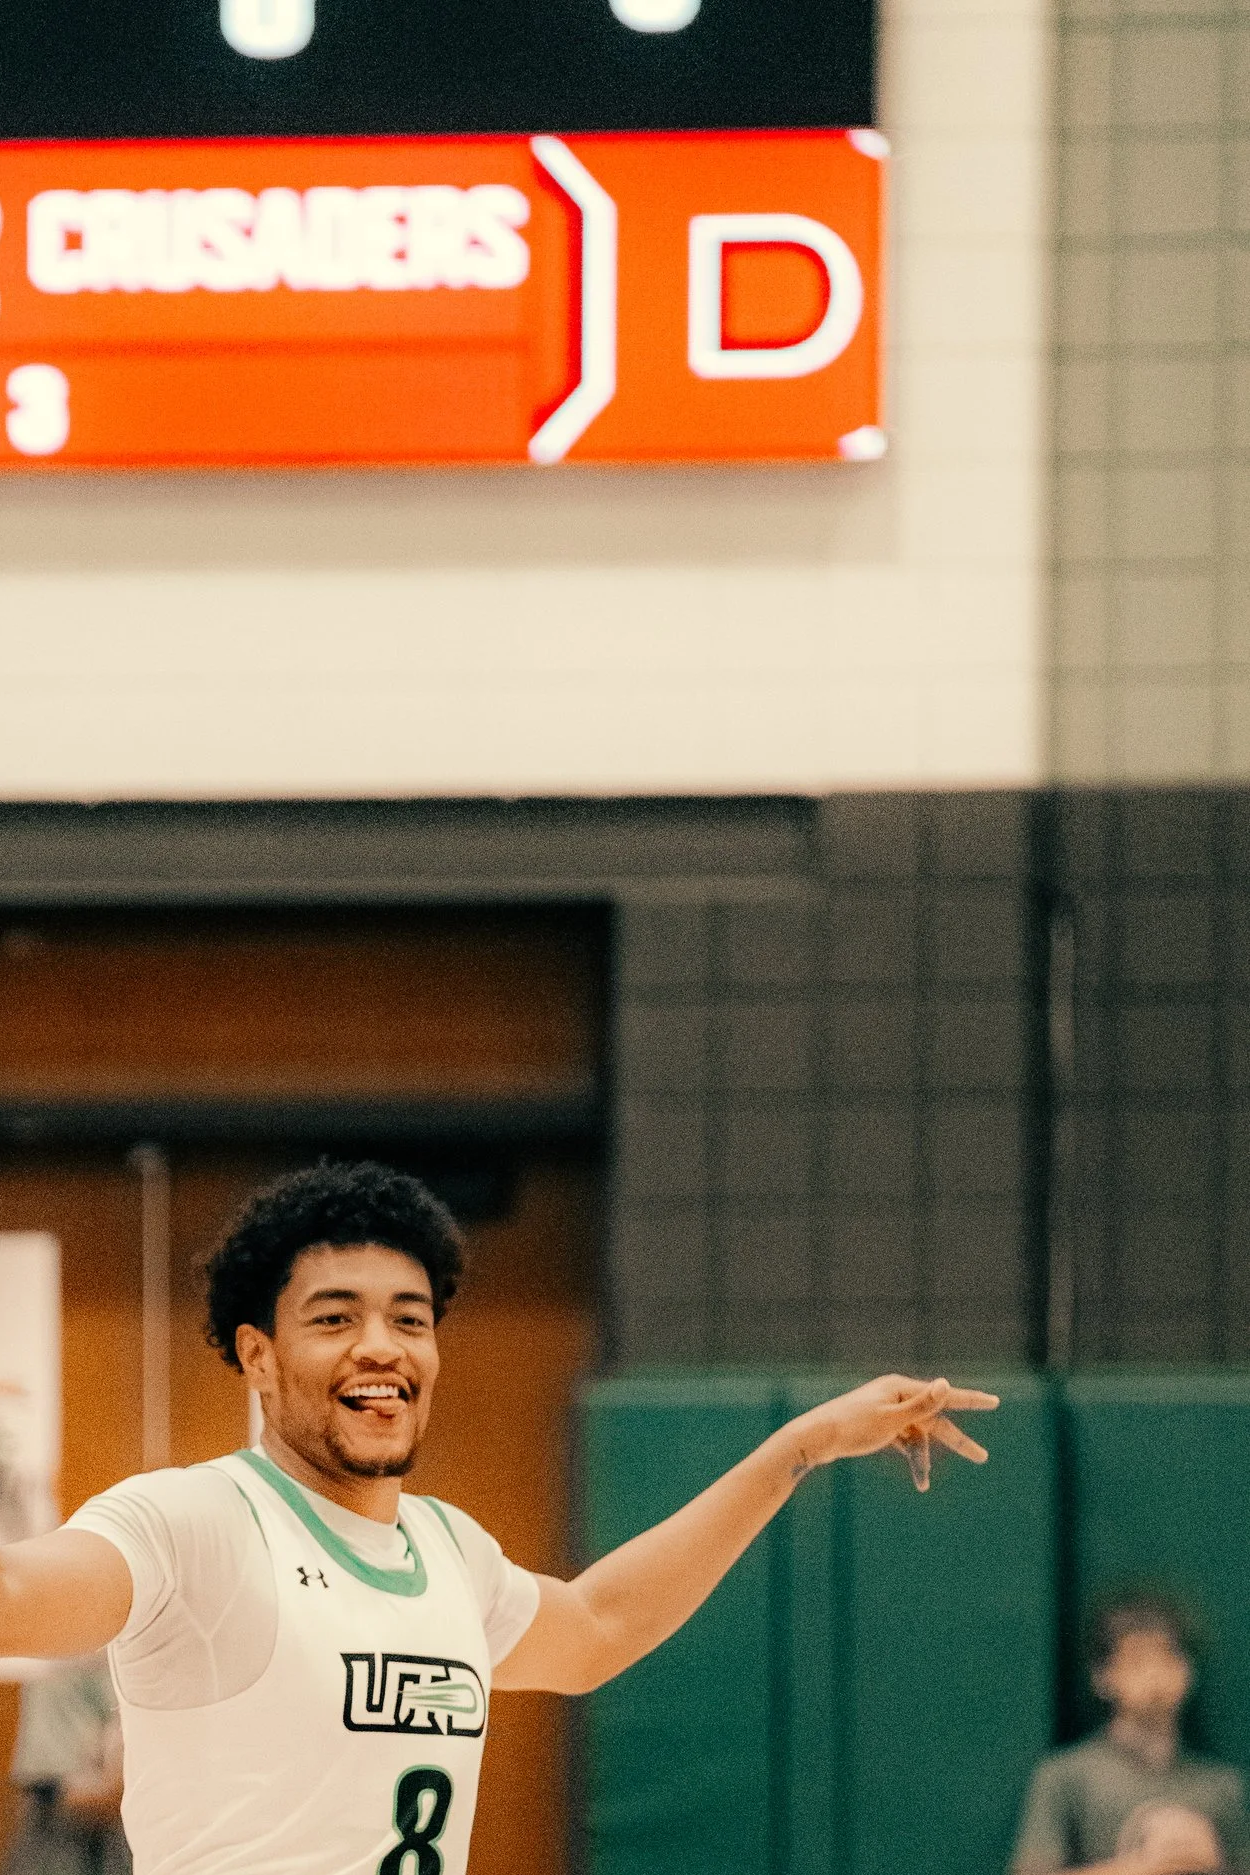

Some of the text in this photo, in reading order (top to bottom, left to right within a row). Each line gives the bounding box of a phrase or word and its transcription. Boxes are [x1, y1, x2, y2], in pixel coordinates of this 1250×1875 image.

[26, 185, 530, 293] CRUSADERS
[687, 213, 864, 378] D
[5, 364, 70, 455] 3
[340, 1652, 487, 1738] UTD
